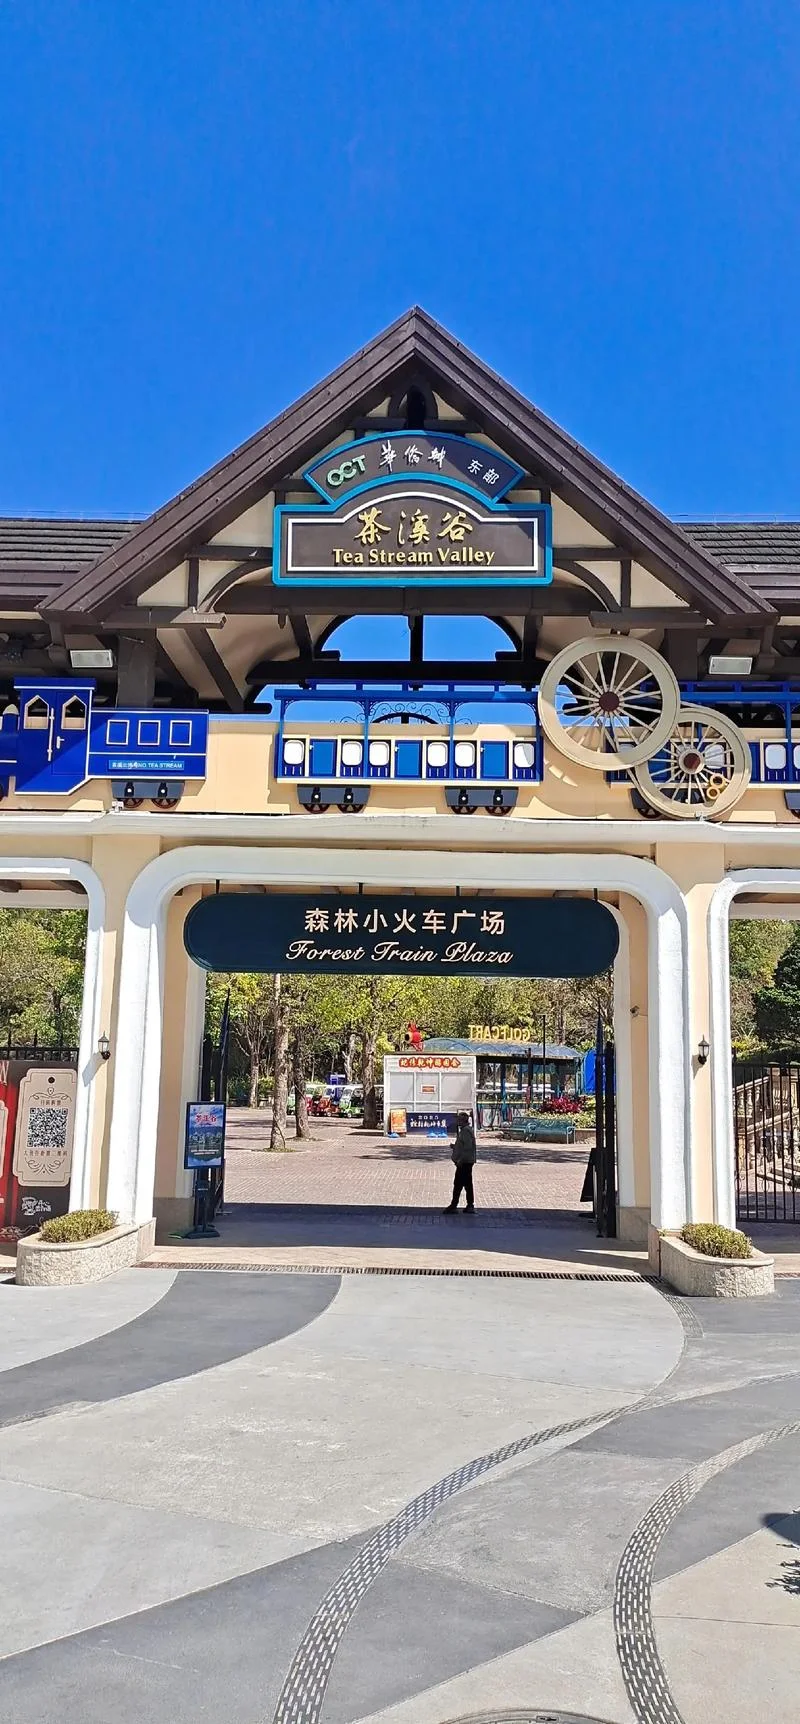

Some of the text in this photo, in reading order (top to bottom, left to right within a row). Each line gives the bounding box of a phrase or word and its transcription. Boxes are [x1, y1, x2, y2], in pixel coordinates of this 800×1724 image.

[326, 455, 367, 487] OCT
[467, 459, 500, 485] 东部
[354, 507, 473, 545] 茶溪谷
[333, 547, 495, 565] Tea Stream Valley
[304, 908, 505, 935] 森林小火车广场
[285, 940, 514, 964] Forest Train Plaza
